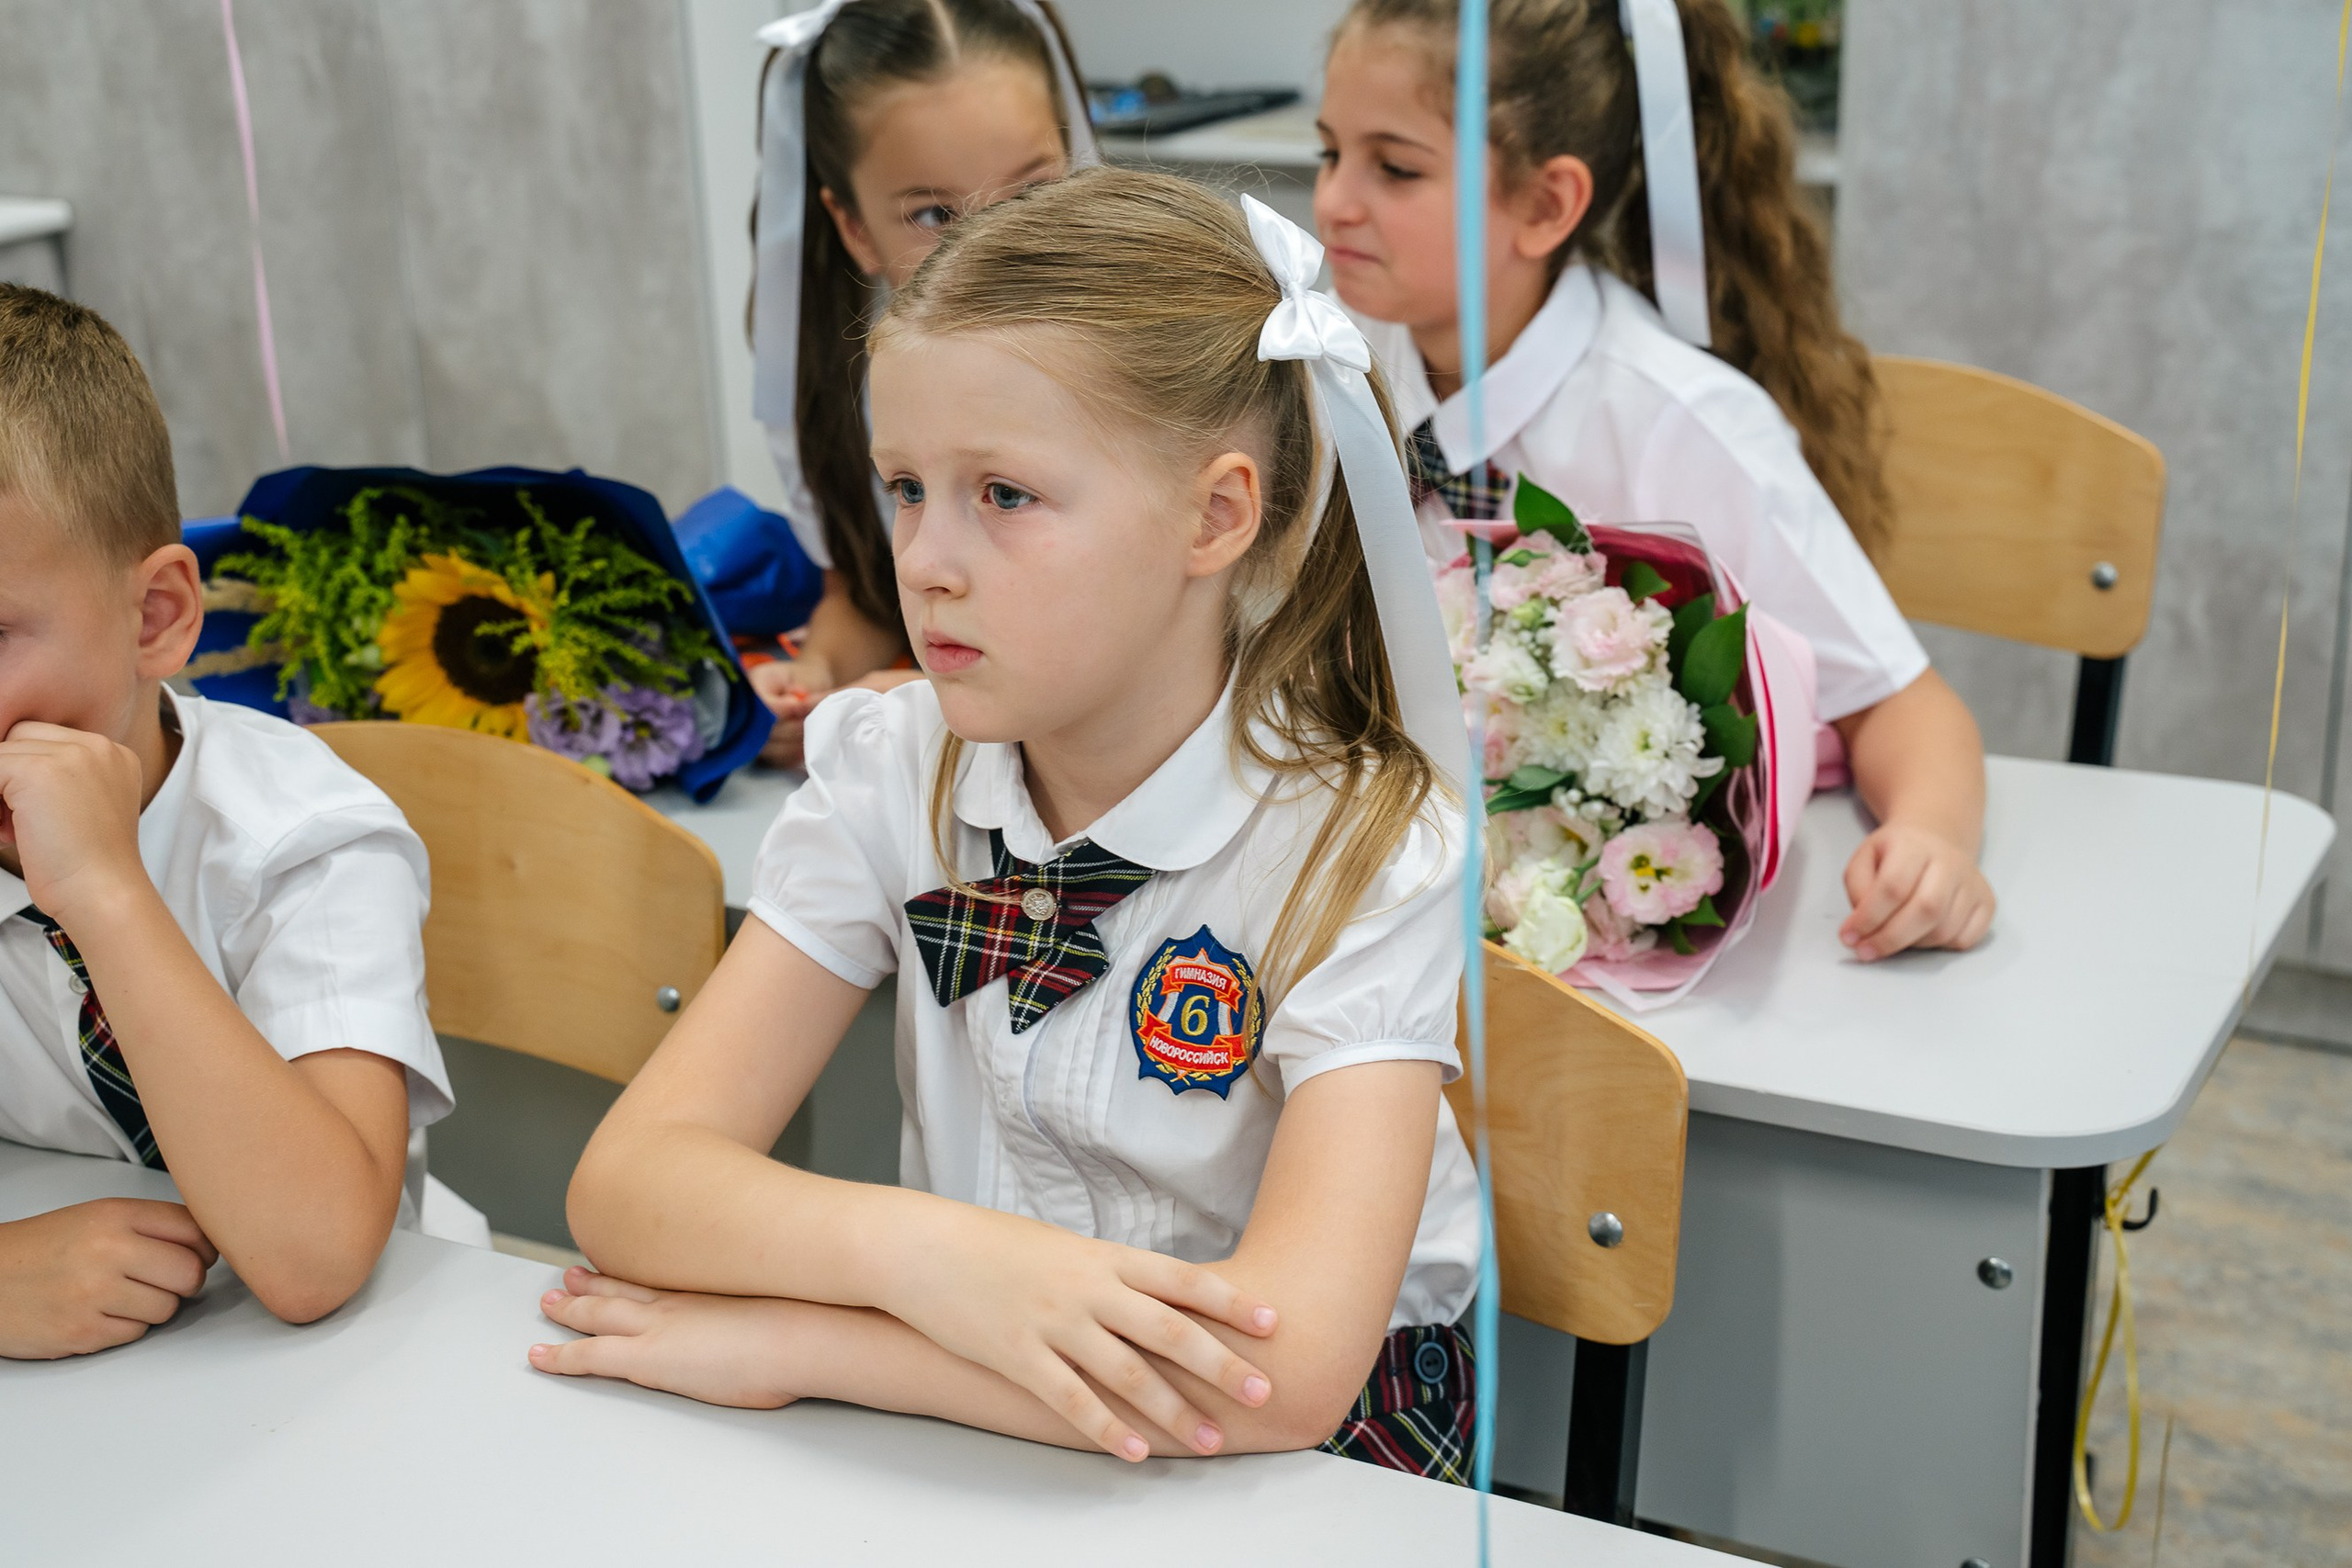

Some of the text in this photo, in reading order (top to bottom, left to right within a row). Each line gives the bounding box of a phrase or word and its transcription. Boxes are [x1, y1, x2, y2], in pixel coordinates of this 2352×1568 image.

[1174, 967, 1227, 990] ГИМНАЗИЯ
[1181, 995, 1210, 1036] 6
[1149, 1035, 1229, 1066] НОВОРОССИЙСК
